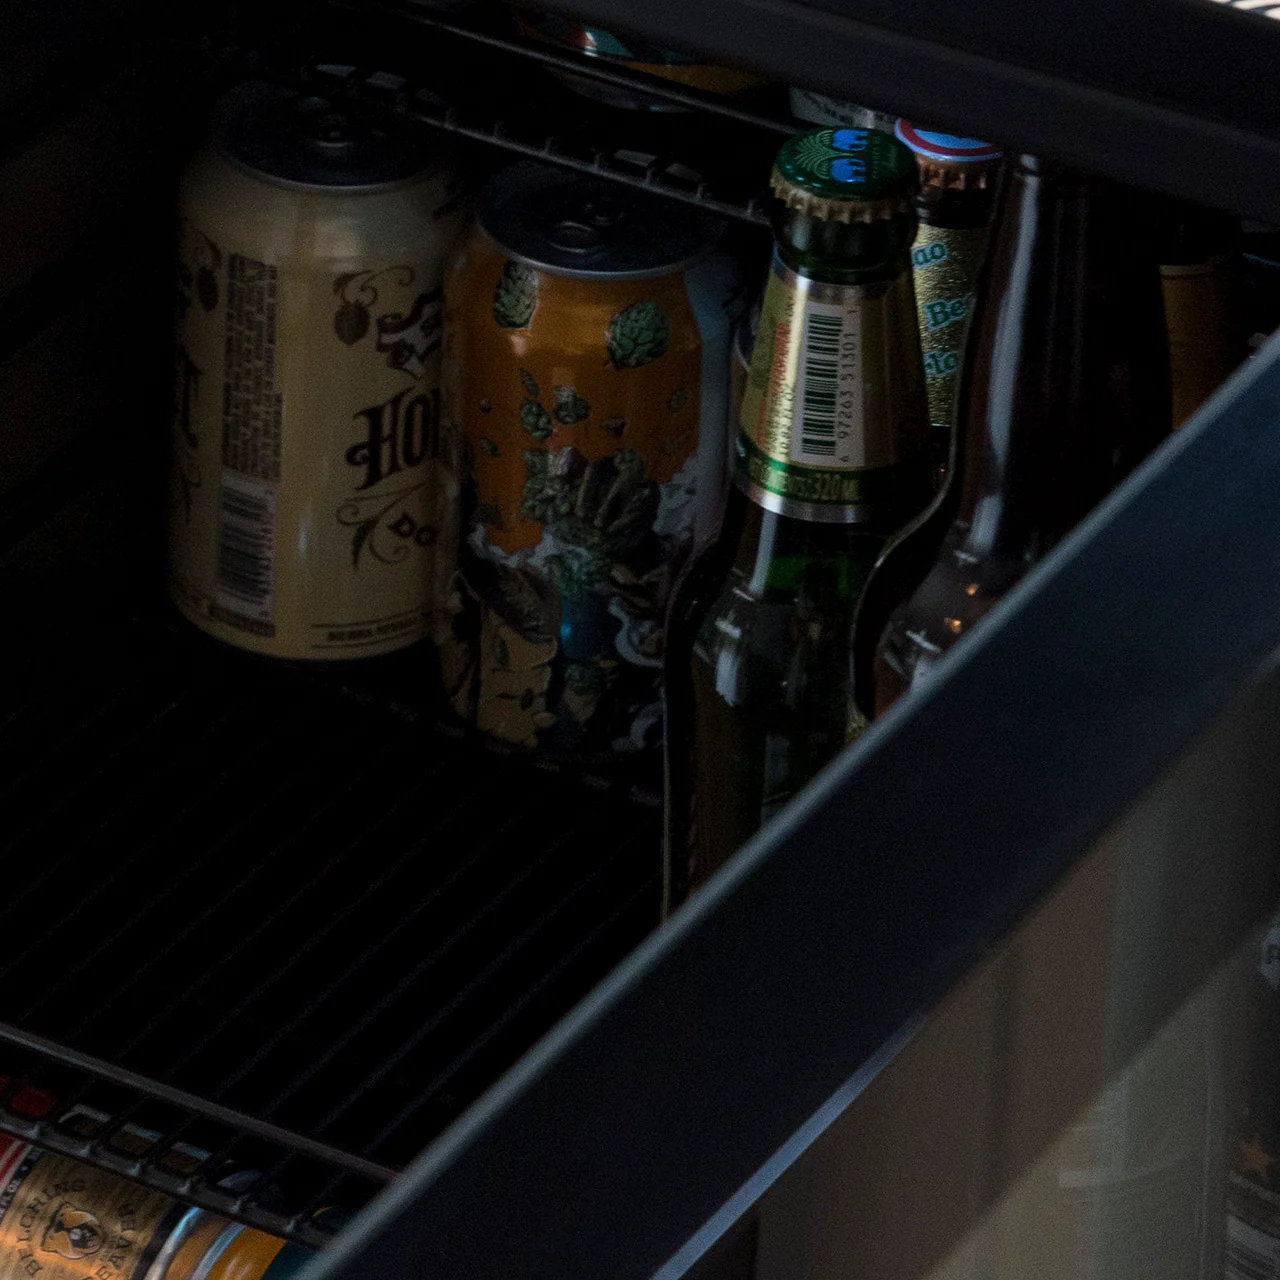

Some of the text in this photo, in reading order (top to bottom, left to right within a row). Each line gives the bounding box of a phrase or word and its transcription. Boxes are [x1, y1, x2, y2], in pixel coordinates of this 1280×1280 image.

[840, 332, 857, 382] 51301
[345, 387, 440, 491] HO
[837, 390, 855, 440] 97263
